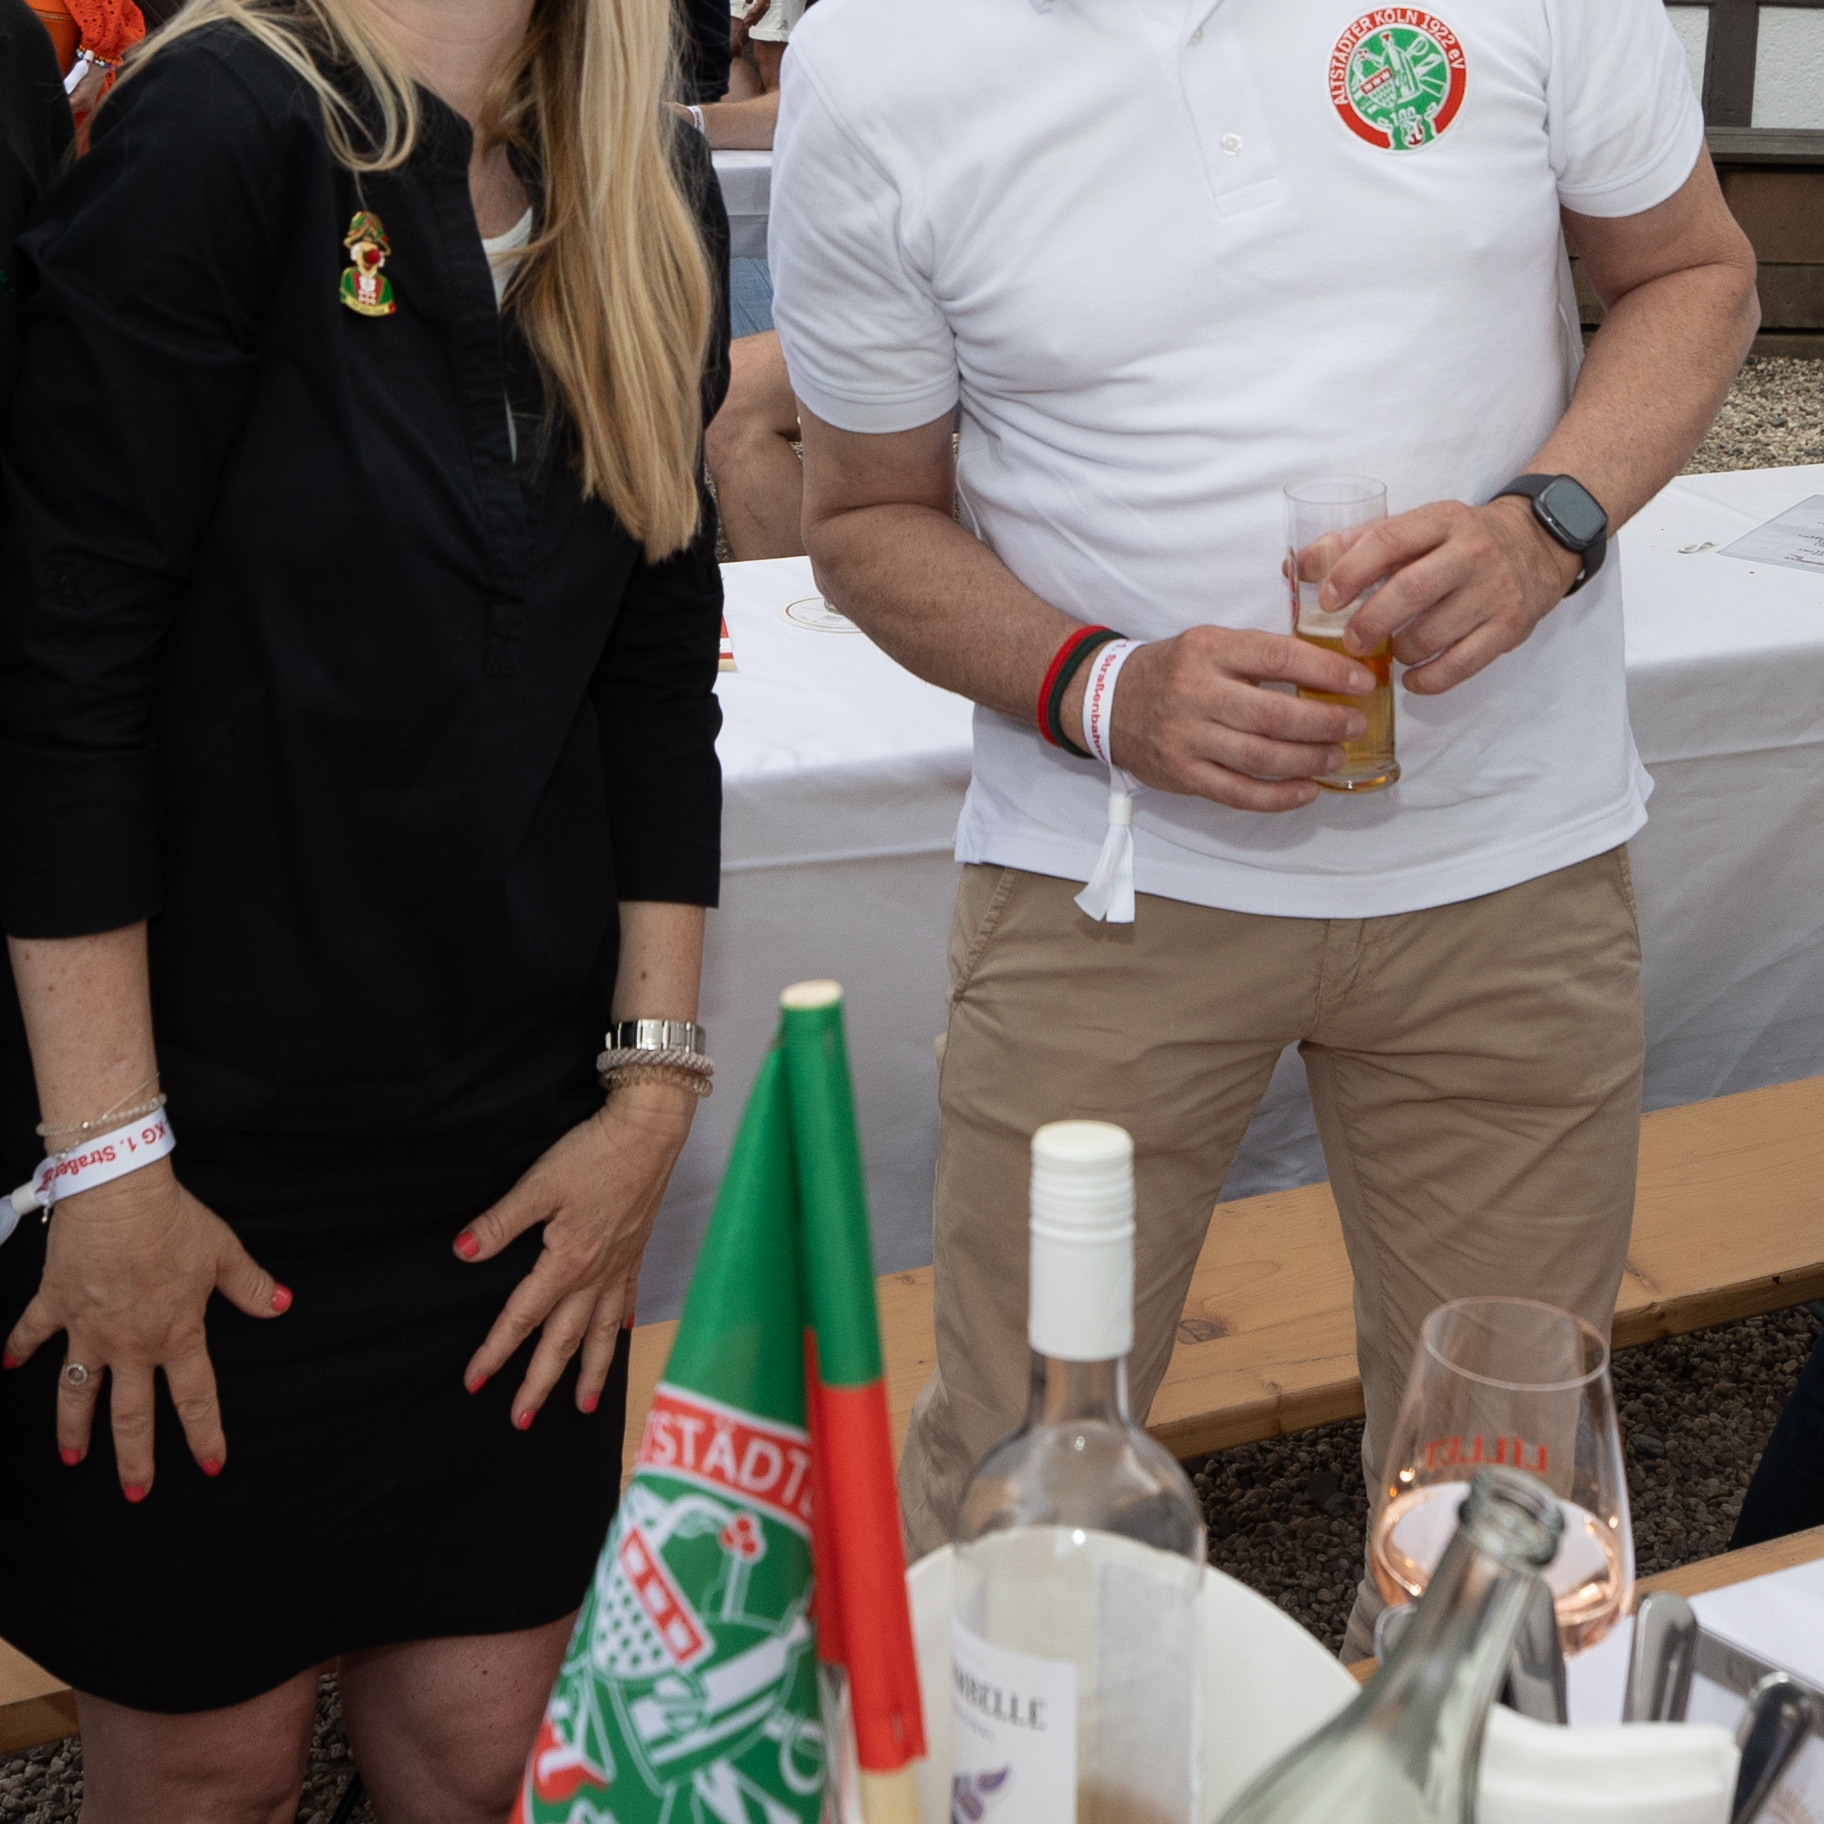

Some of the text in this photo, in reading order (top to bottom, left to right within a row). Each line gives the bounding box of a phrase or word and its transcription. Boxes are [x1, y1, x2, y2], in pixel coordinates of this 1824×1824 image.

[1329, 16, 1374, 106] ALTSTÄDTER
[1374, 8, 1419, 26] KÖLN
[1421, 15, 1457, 49] 1922
